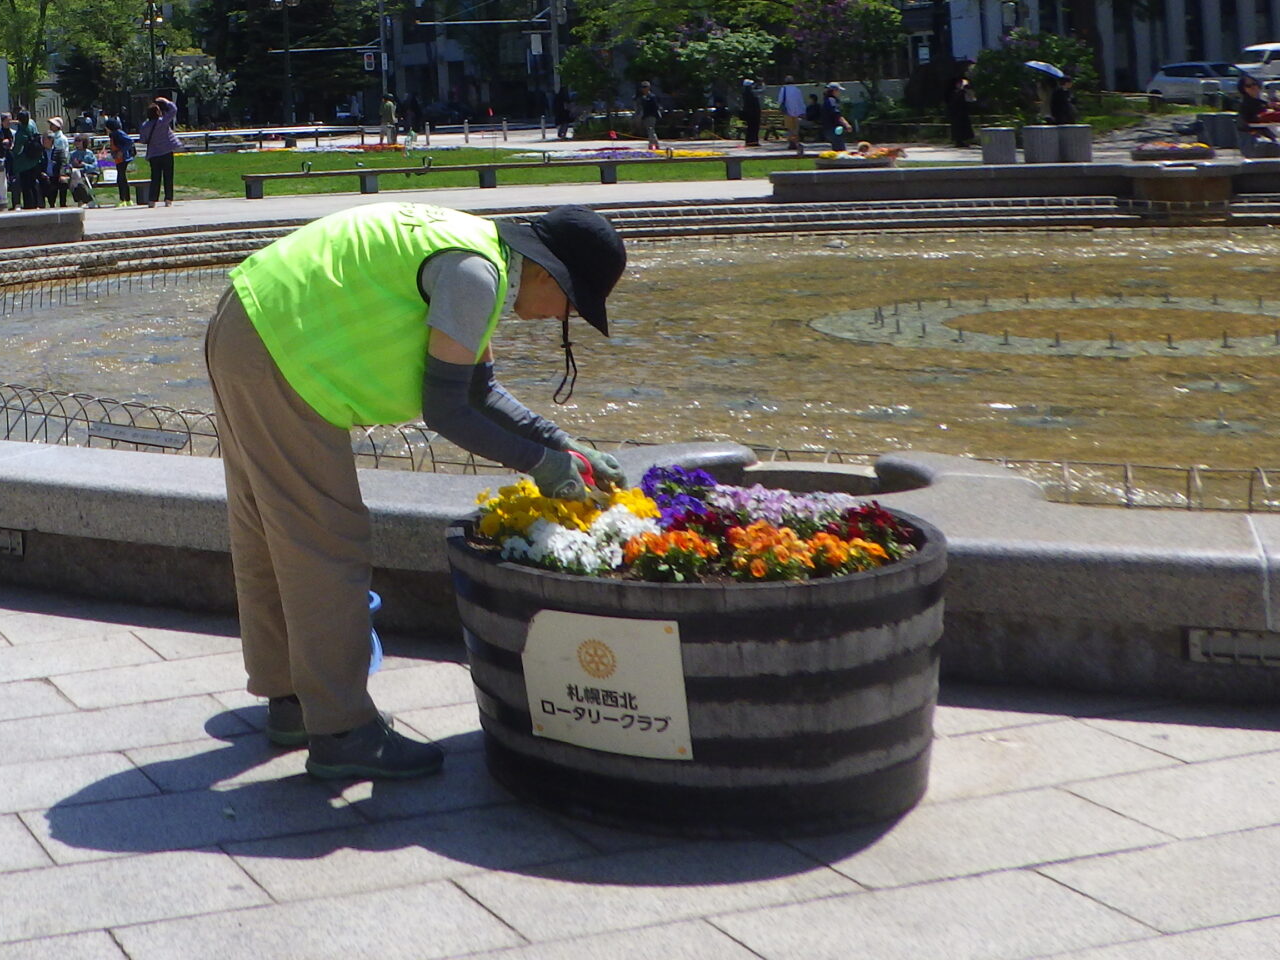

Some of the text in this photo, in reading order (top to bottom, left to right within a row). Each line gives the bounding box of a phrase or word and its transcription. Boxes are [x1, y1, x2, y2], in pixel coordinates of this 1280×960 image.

[566, 683, 638, 711] 札幌西北
[541, 698, 672, 733] ロータリークラブ
